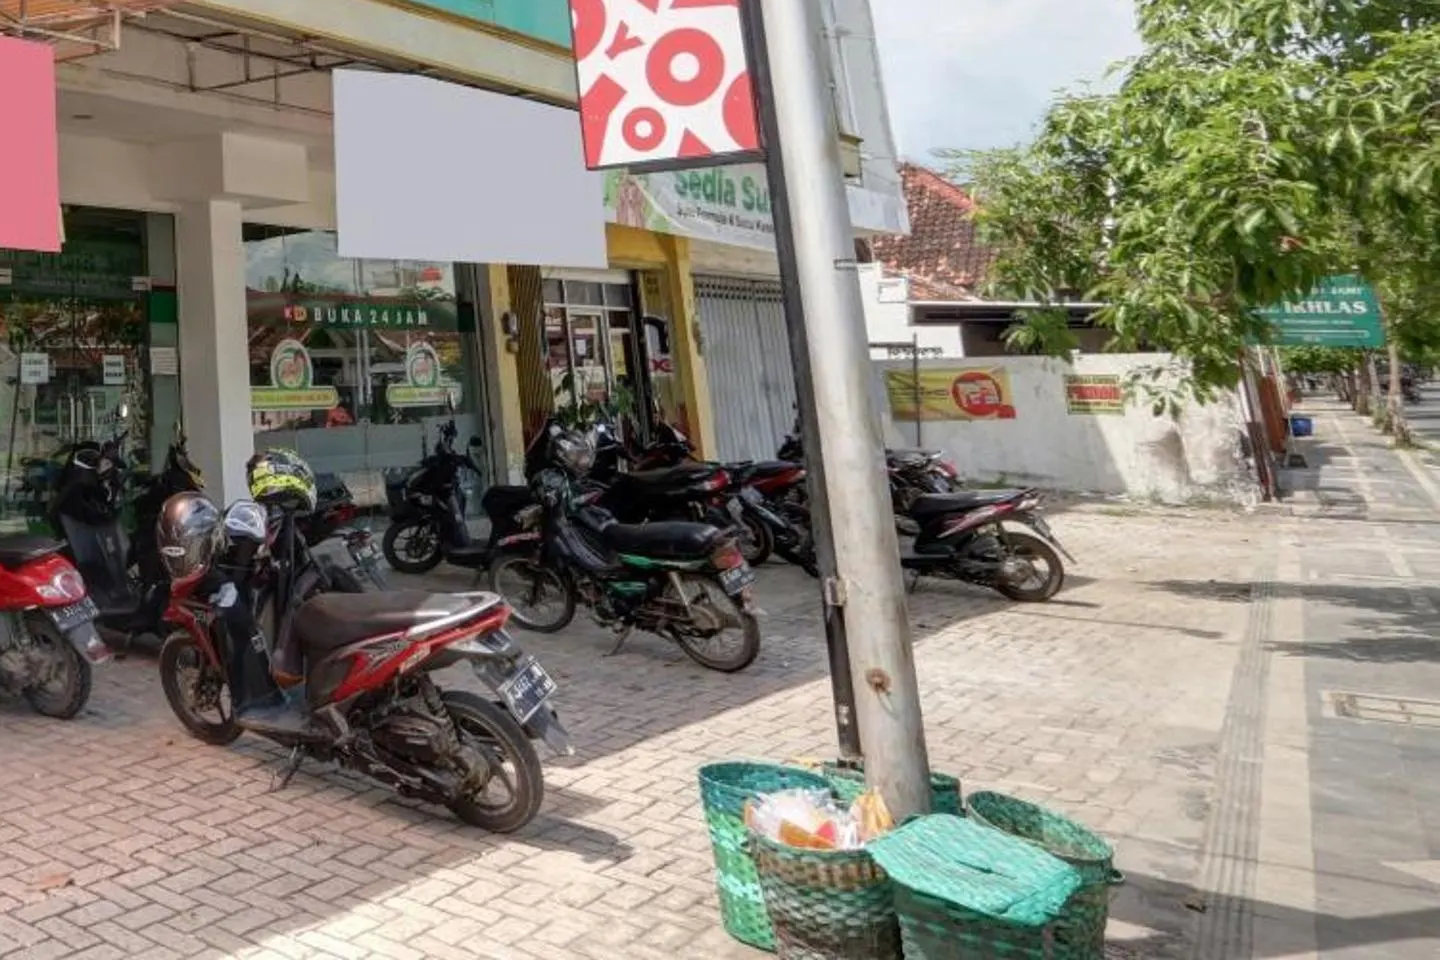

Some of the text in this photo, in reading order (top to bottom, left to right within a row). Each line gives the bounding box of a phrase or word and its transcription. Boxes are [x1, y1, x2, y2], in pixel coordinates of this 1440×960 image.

[314, 306, 362, 324] BUKA
[370, 308, 389, 324] 24
[1283, 299, 1368, 315] IKHLAS
